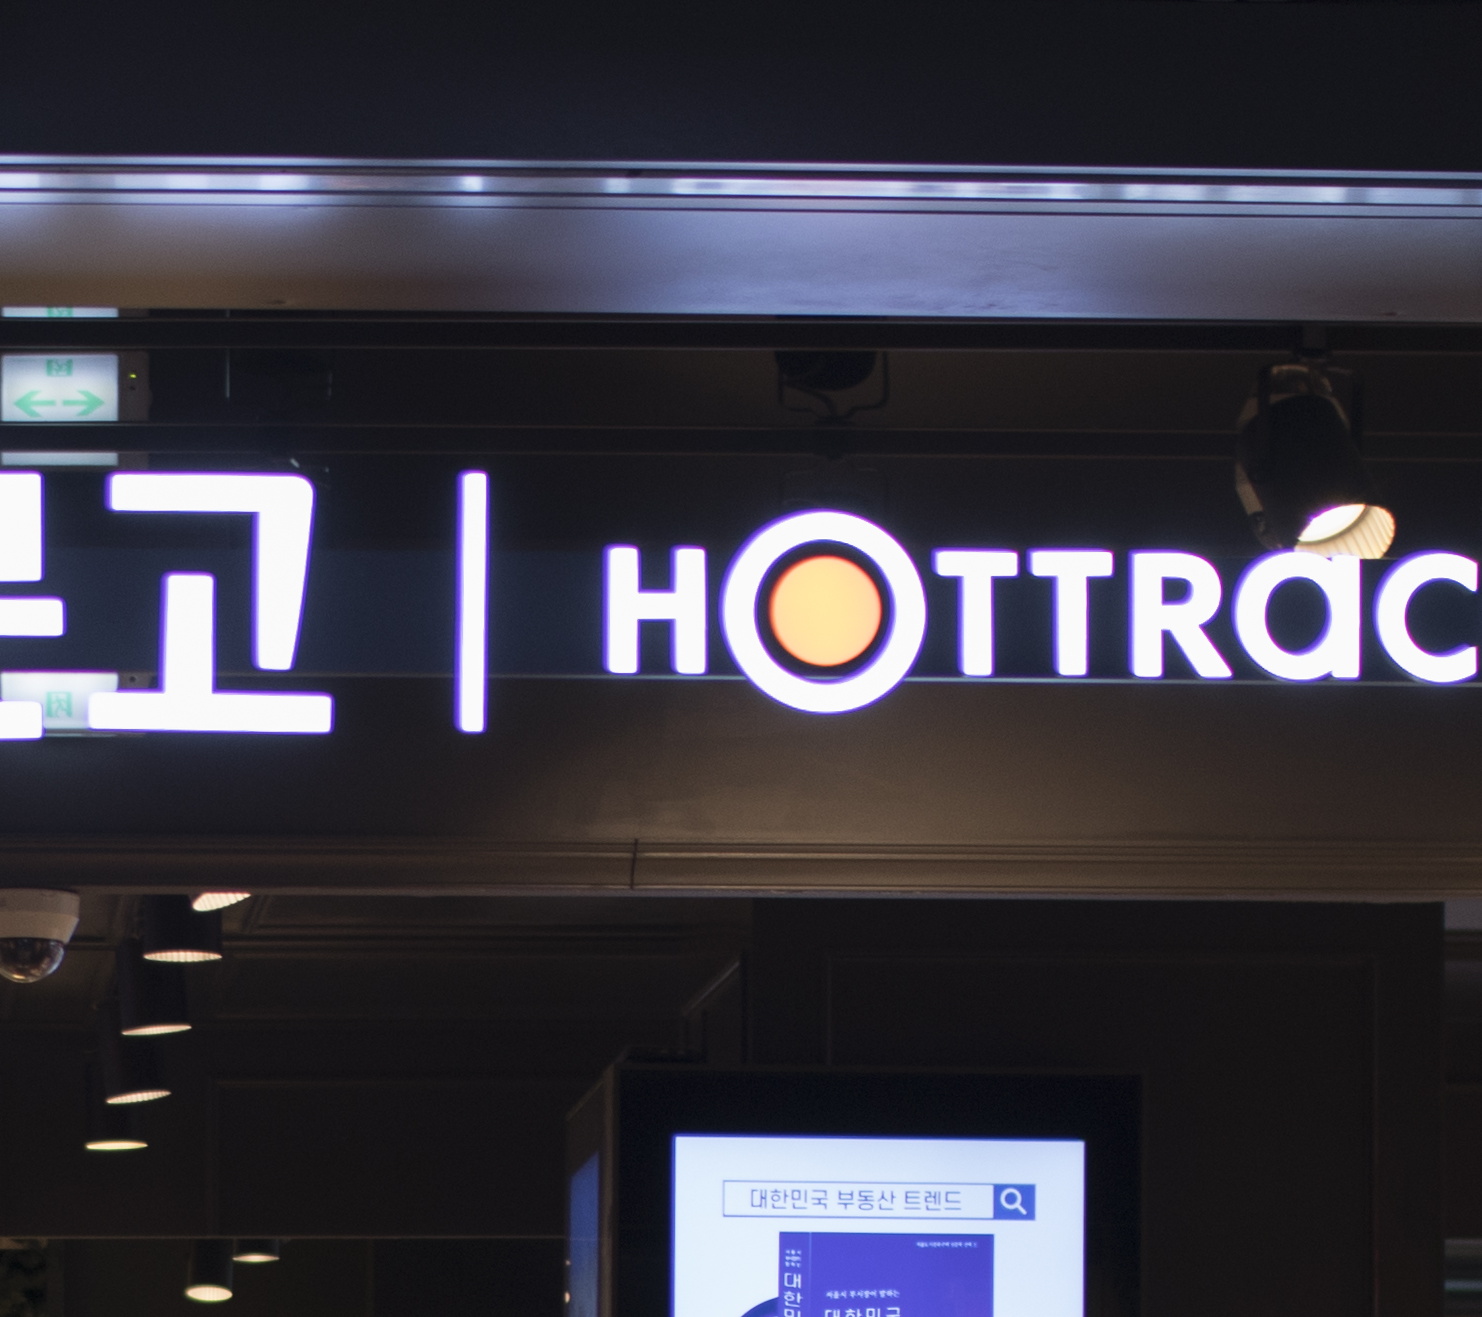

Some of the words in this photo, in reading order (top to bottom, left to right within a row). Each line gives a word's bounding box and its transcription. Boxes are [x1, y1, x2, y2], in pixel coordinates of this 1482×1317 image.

[750, 1188, 828, 1211] 대한민국
[838, 1188, 895, 1211] 부동산
[904, 1188, 962, 1211] 트렌드
